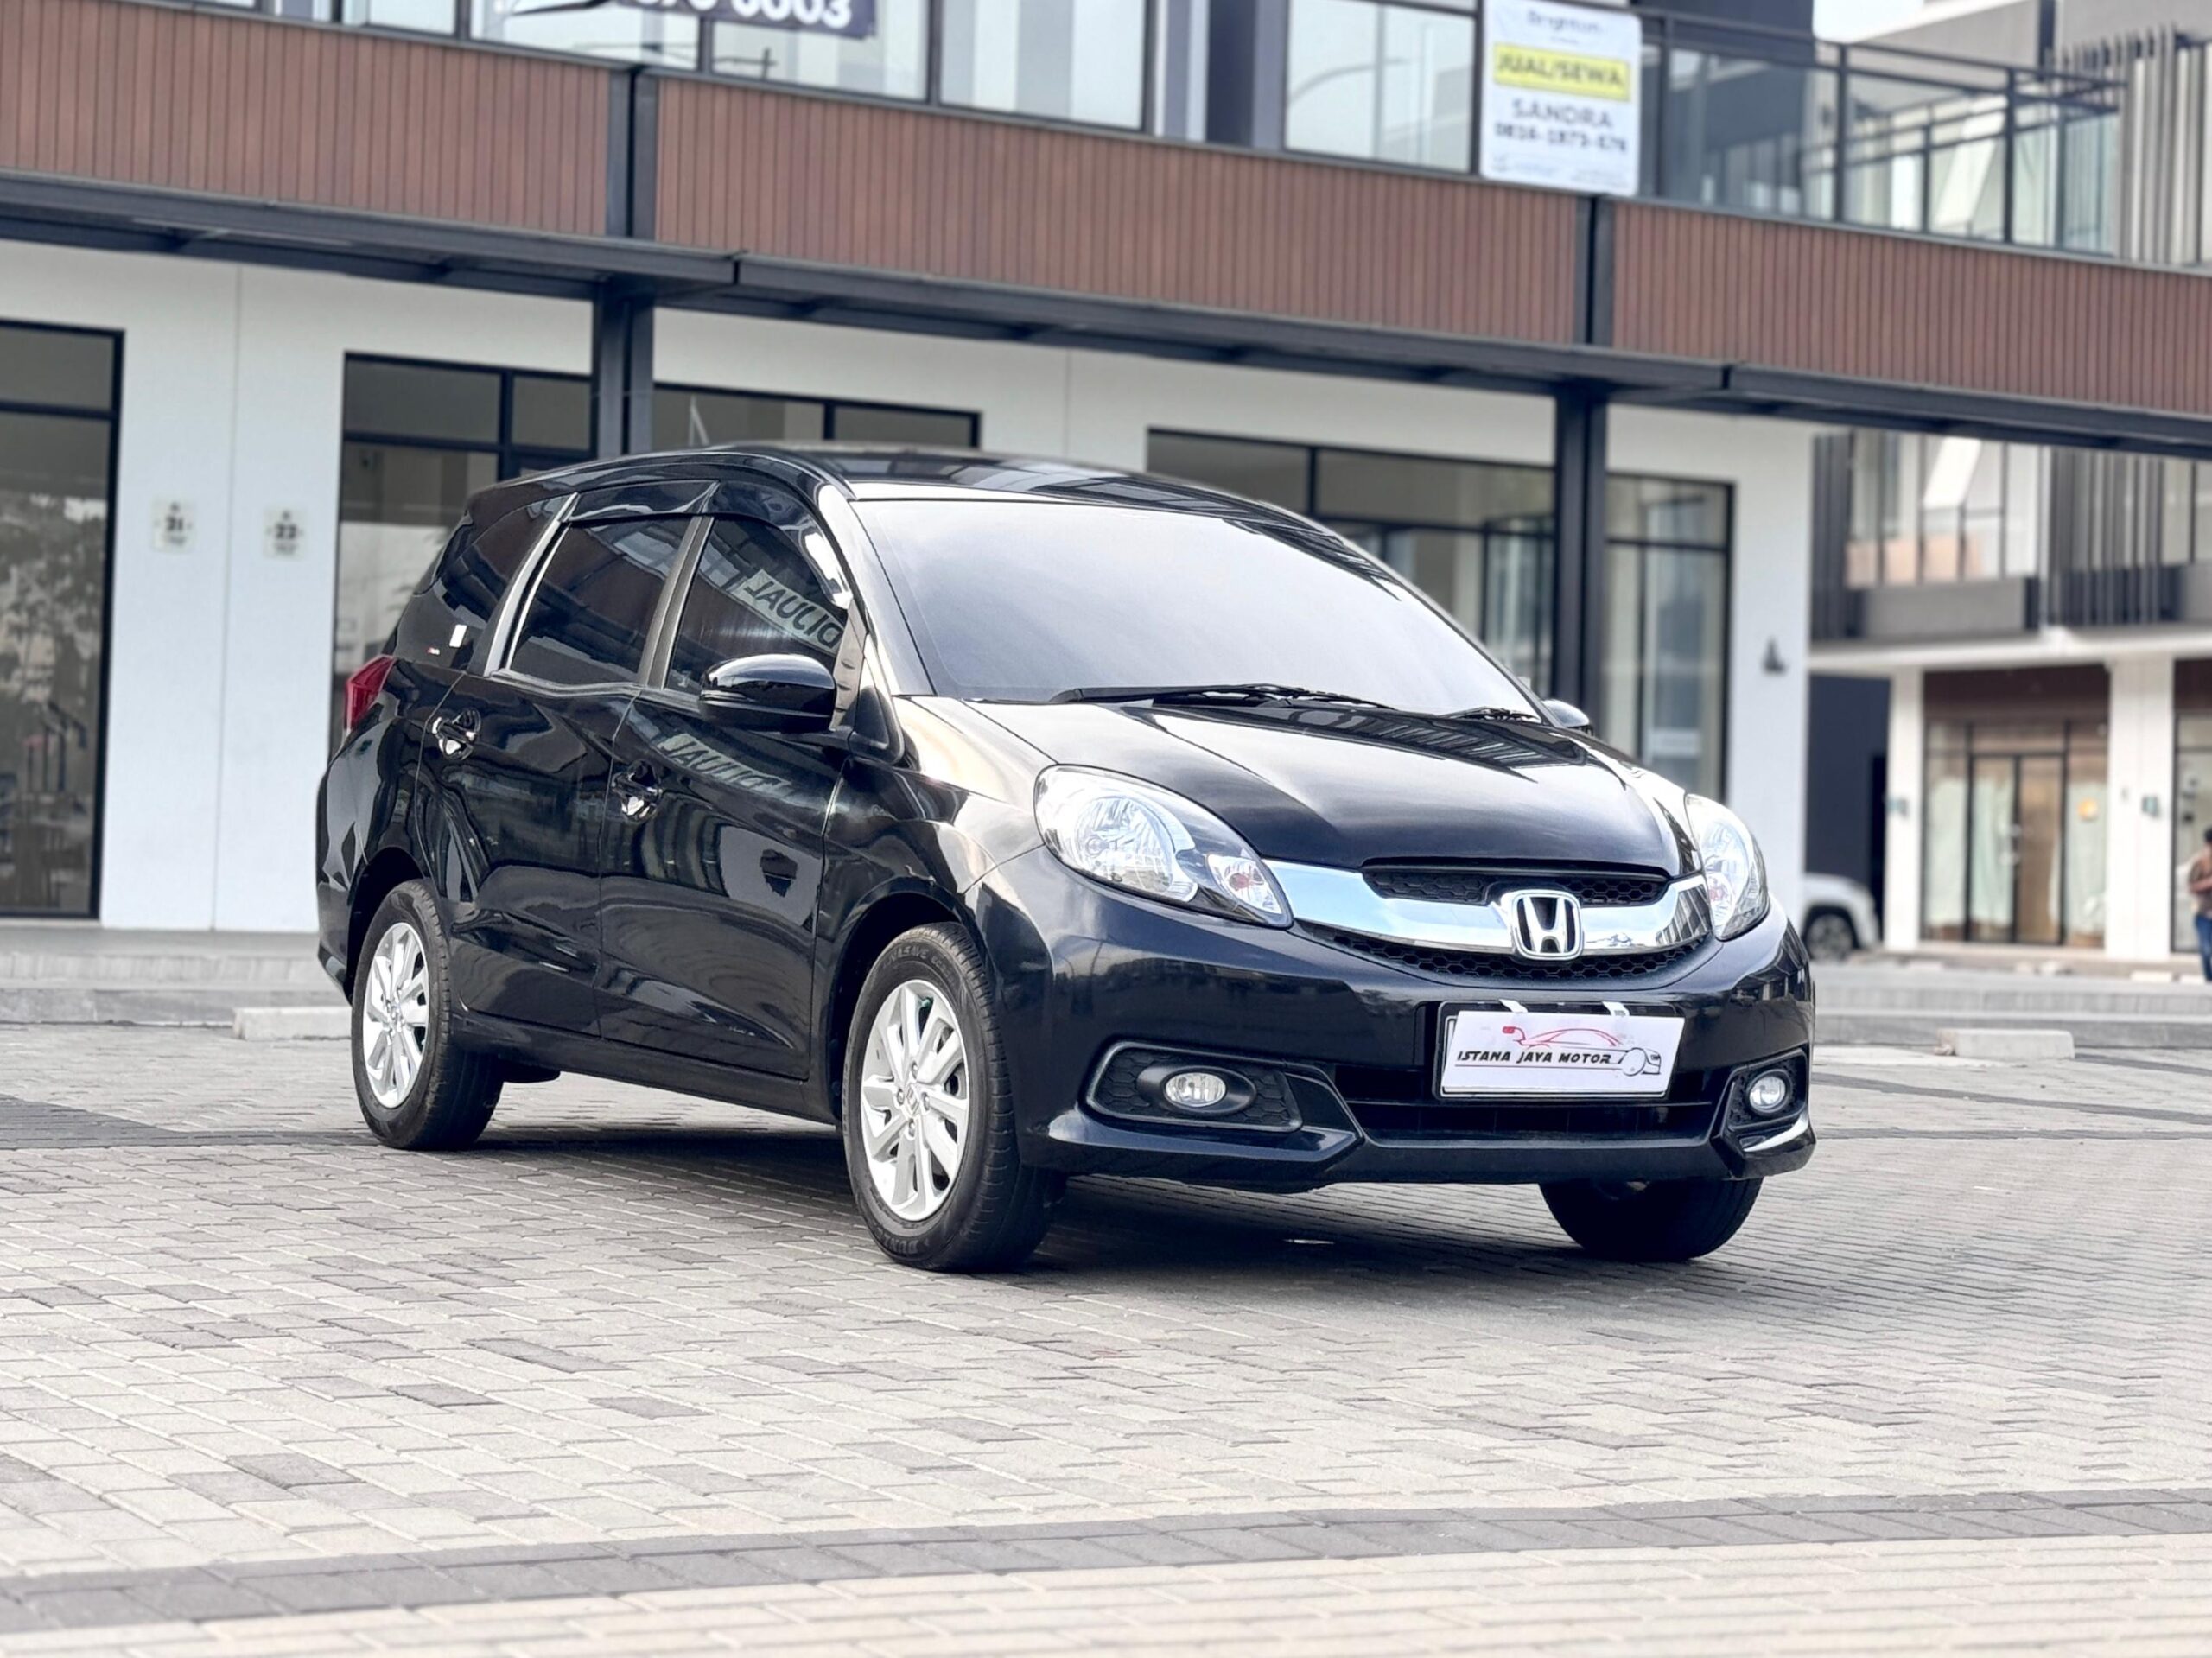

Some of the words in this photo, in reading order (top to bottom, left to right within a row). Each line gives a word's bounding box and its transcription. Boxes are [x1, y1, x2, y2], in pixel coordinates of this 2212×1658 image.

[1457, 1051, 1511, 1062] ISTANA
[1516, 1051, 1553, 1064] JAYA
[1558, 1053, 1611, 1064] MOTOR
